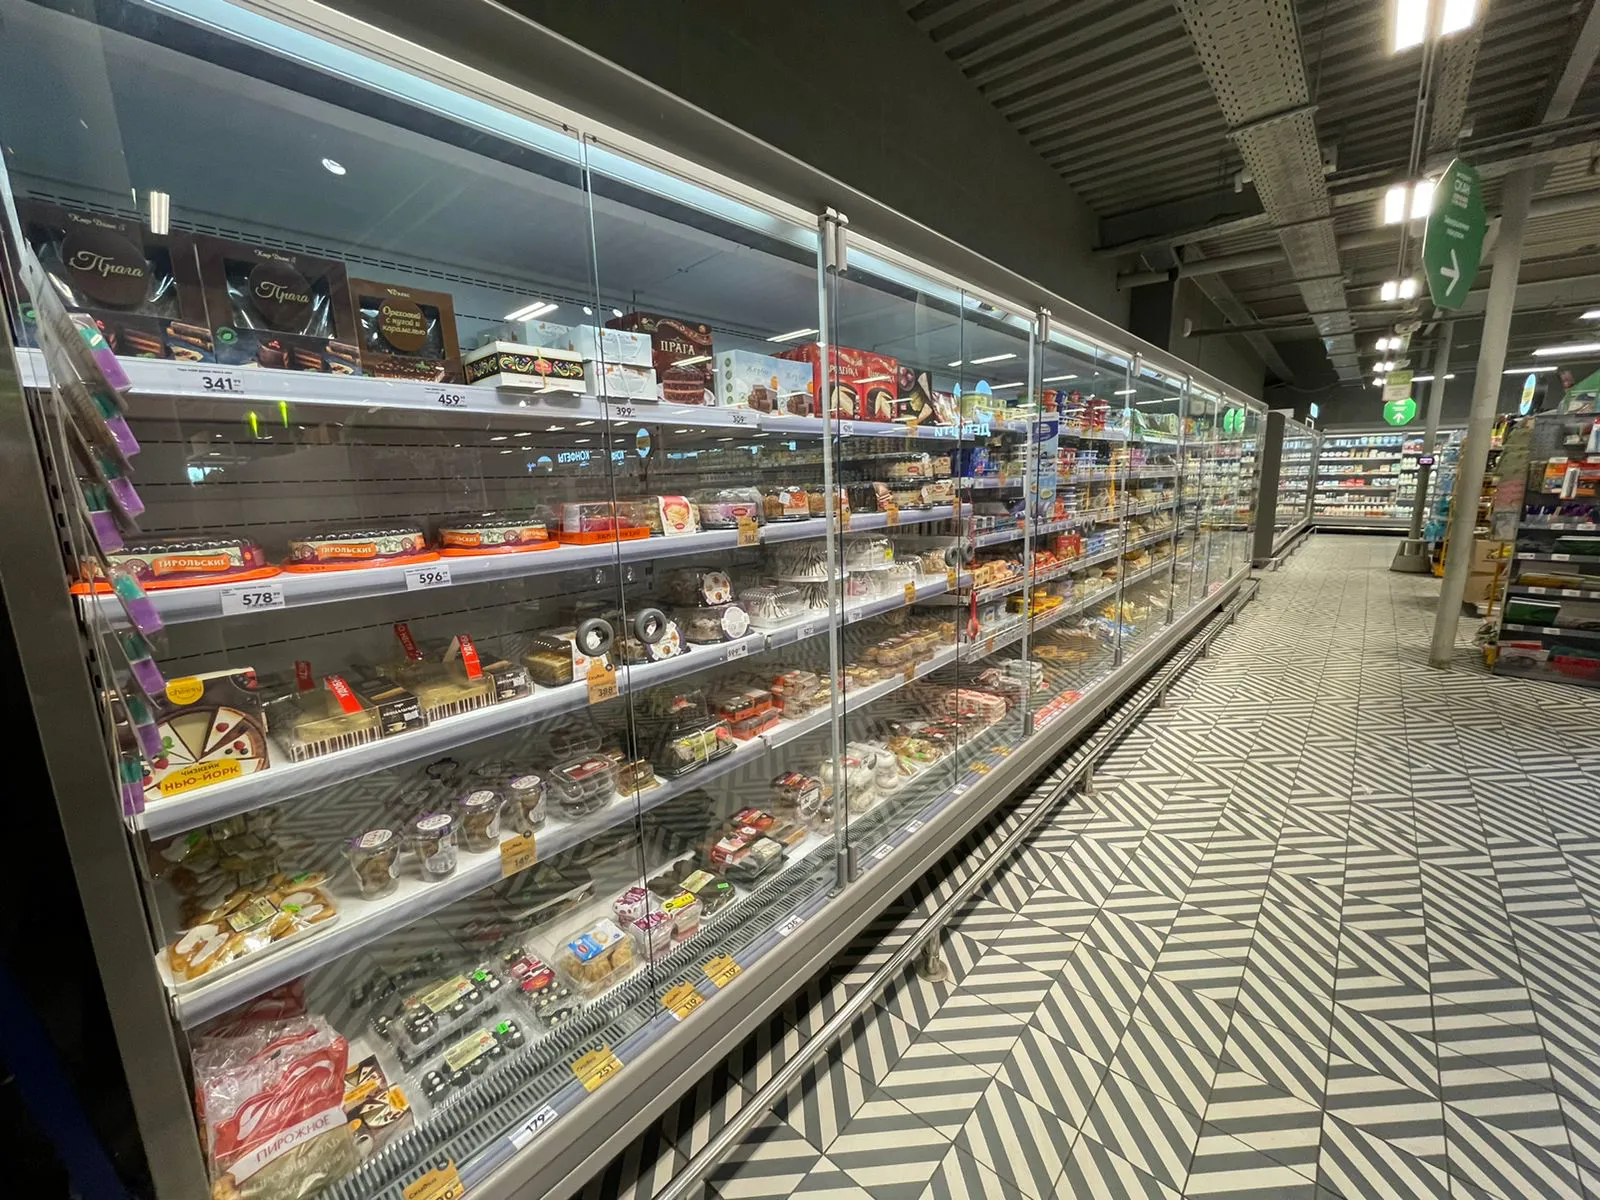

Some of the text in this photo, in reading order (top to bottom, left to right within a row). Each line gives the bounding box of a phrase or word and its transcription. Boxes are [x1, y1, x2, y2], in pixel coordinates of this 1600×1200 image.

[69, 251, 144, 277] Прага
[255, 281, 309, 303] Прага
[660, 340, 695, 355] ПРАГА
[202, 376, 233, 390] 341
[438, 394, 460, 405] 459
[616, 406, 632, 417] 399
[419, 571, 443, 584] 596
[242, 592, 273, 606] 578
[181, 763, 220, 776] ЧИЗКЕЙК
[165, 766, 239, 791] НЬЮ-ЙОРК
[524, 1113, 546, 1133] 179
[255, 1114, 331, 1163] ПИРОЖНОЕ
